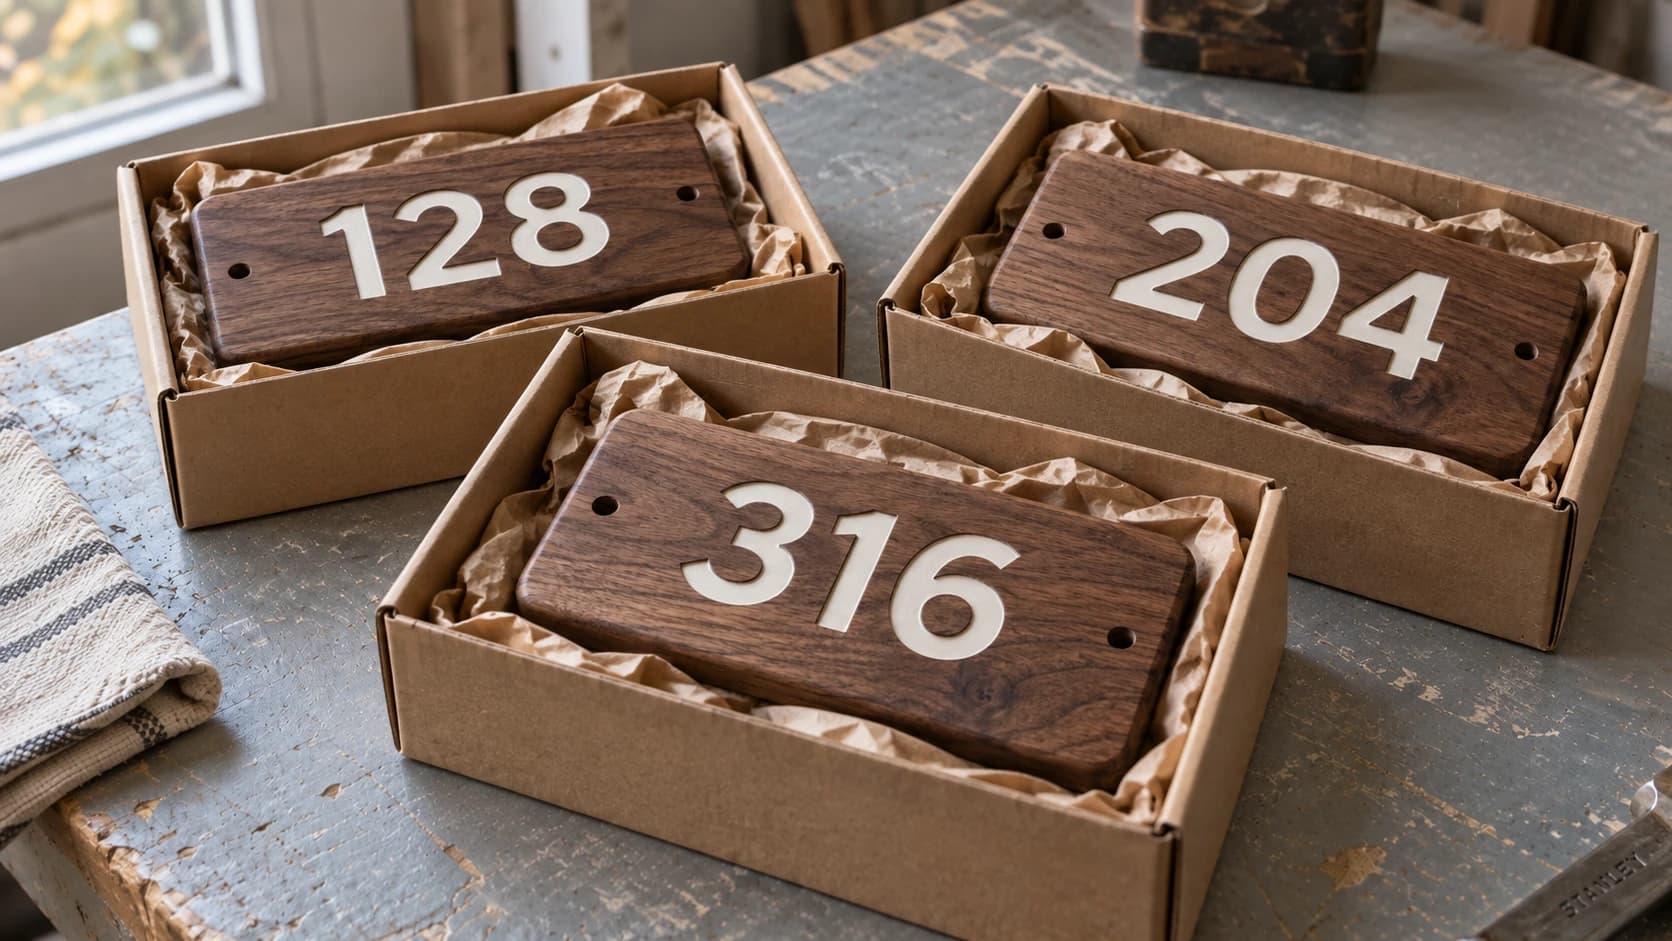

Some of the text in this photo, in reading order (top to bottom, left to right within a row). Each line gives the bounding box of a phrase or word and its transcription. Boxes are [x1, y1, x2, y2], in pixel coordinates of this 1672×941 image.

[319, 172, 611, 300] 128
[1110, 211, 1450, 381] 204
[682, 483, 1022, 661] 316
[1560, 851, 1647, 918] STANLEY
